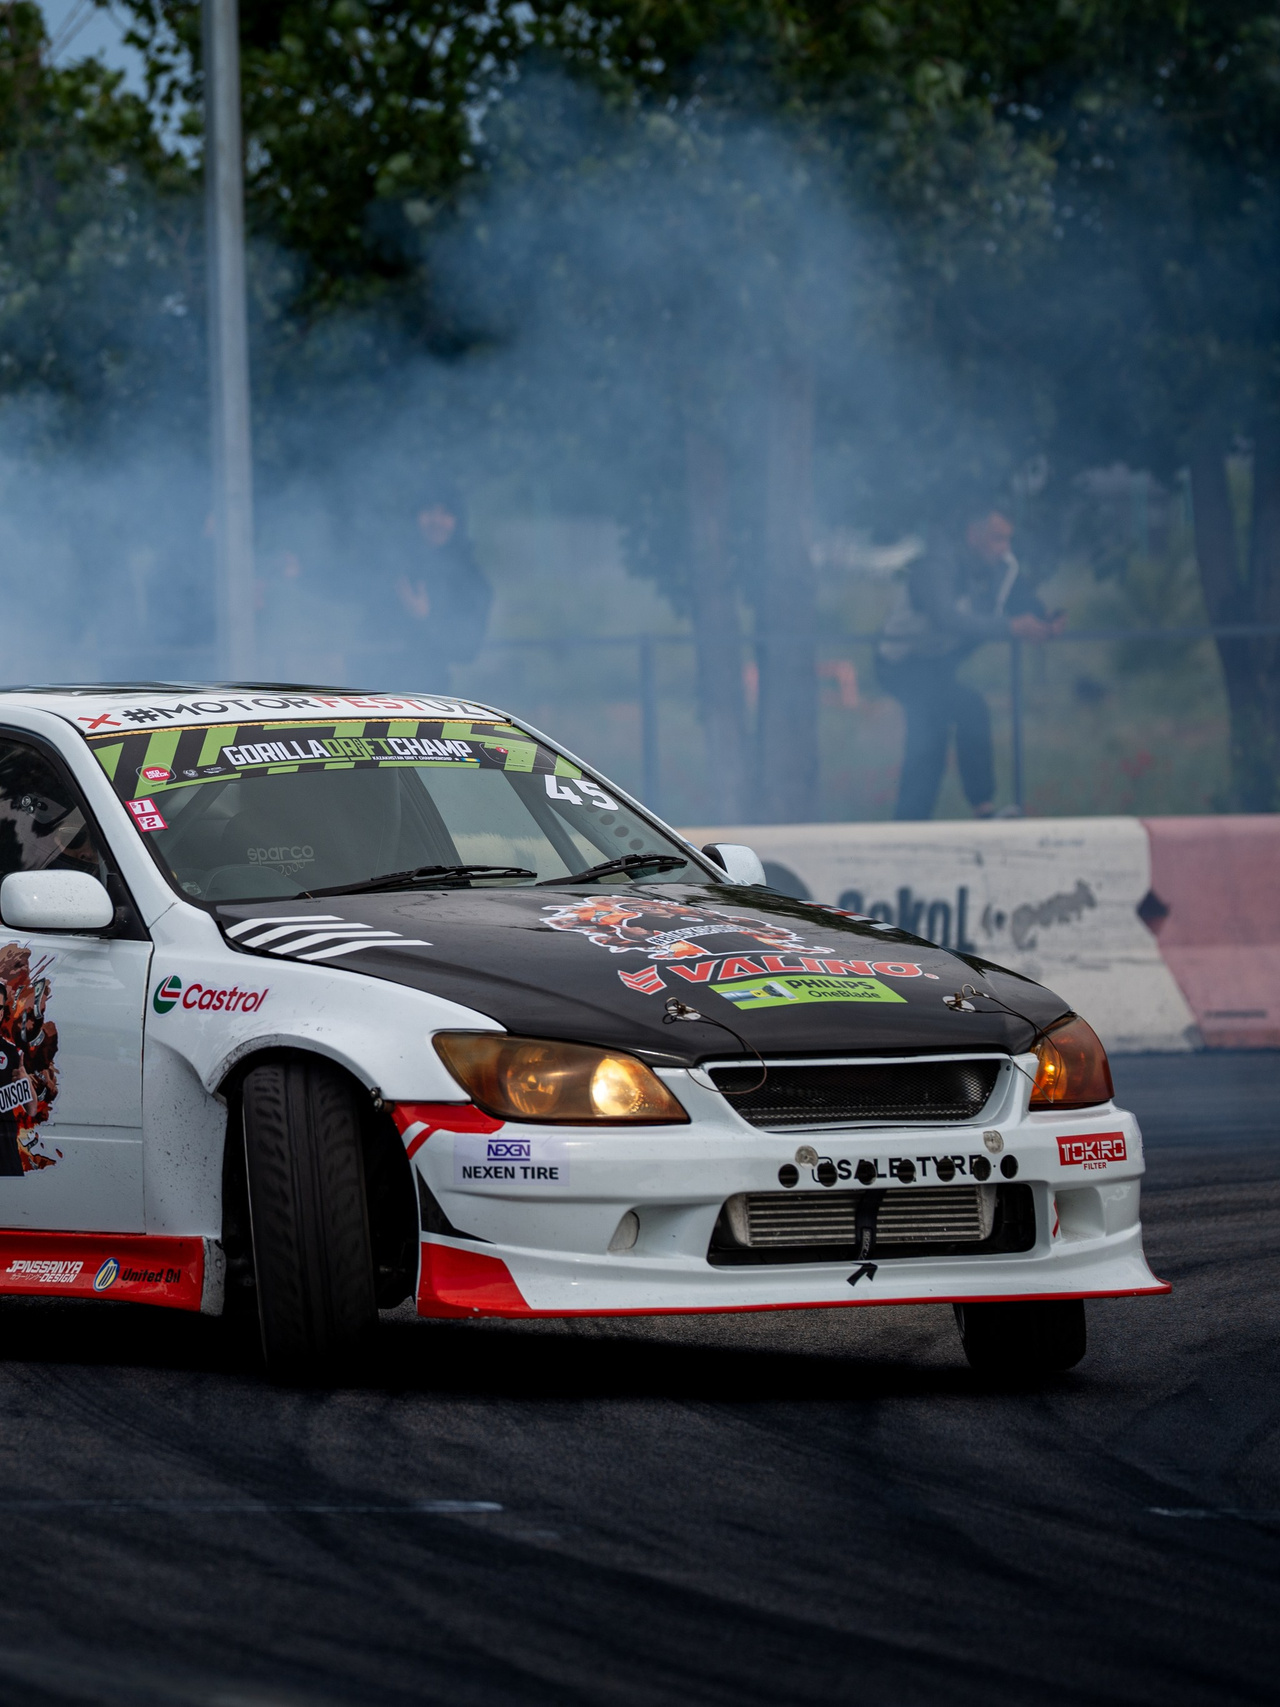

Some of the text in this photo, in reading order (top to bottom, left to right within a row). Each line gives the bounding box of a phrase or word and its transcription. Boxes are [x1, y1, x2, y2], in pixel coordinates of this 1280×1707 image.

[544, 774, 619, 811] 45
[247, 845, 315, 865] sparco
[665, 955, 923, 983] VALINO
[785, 979, 876, 990] PHILIPS
[182, 983, 269, 1012] Castrol
[808, 990, 881, 999] OneBlade
[487, 1144, 531, 1157] NEXEN
[1061, 1139, 1125, 1161] TOKIRO
[462, 1165, 559, 1180] NEXEN TIRE
[1083, 1161, 1107, 1170] FILTER
[121, 1268, 181, 1283] United Oil
